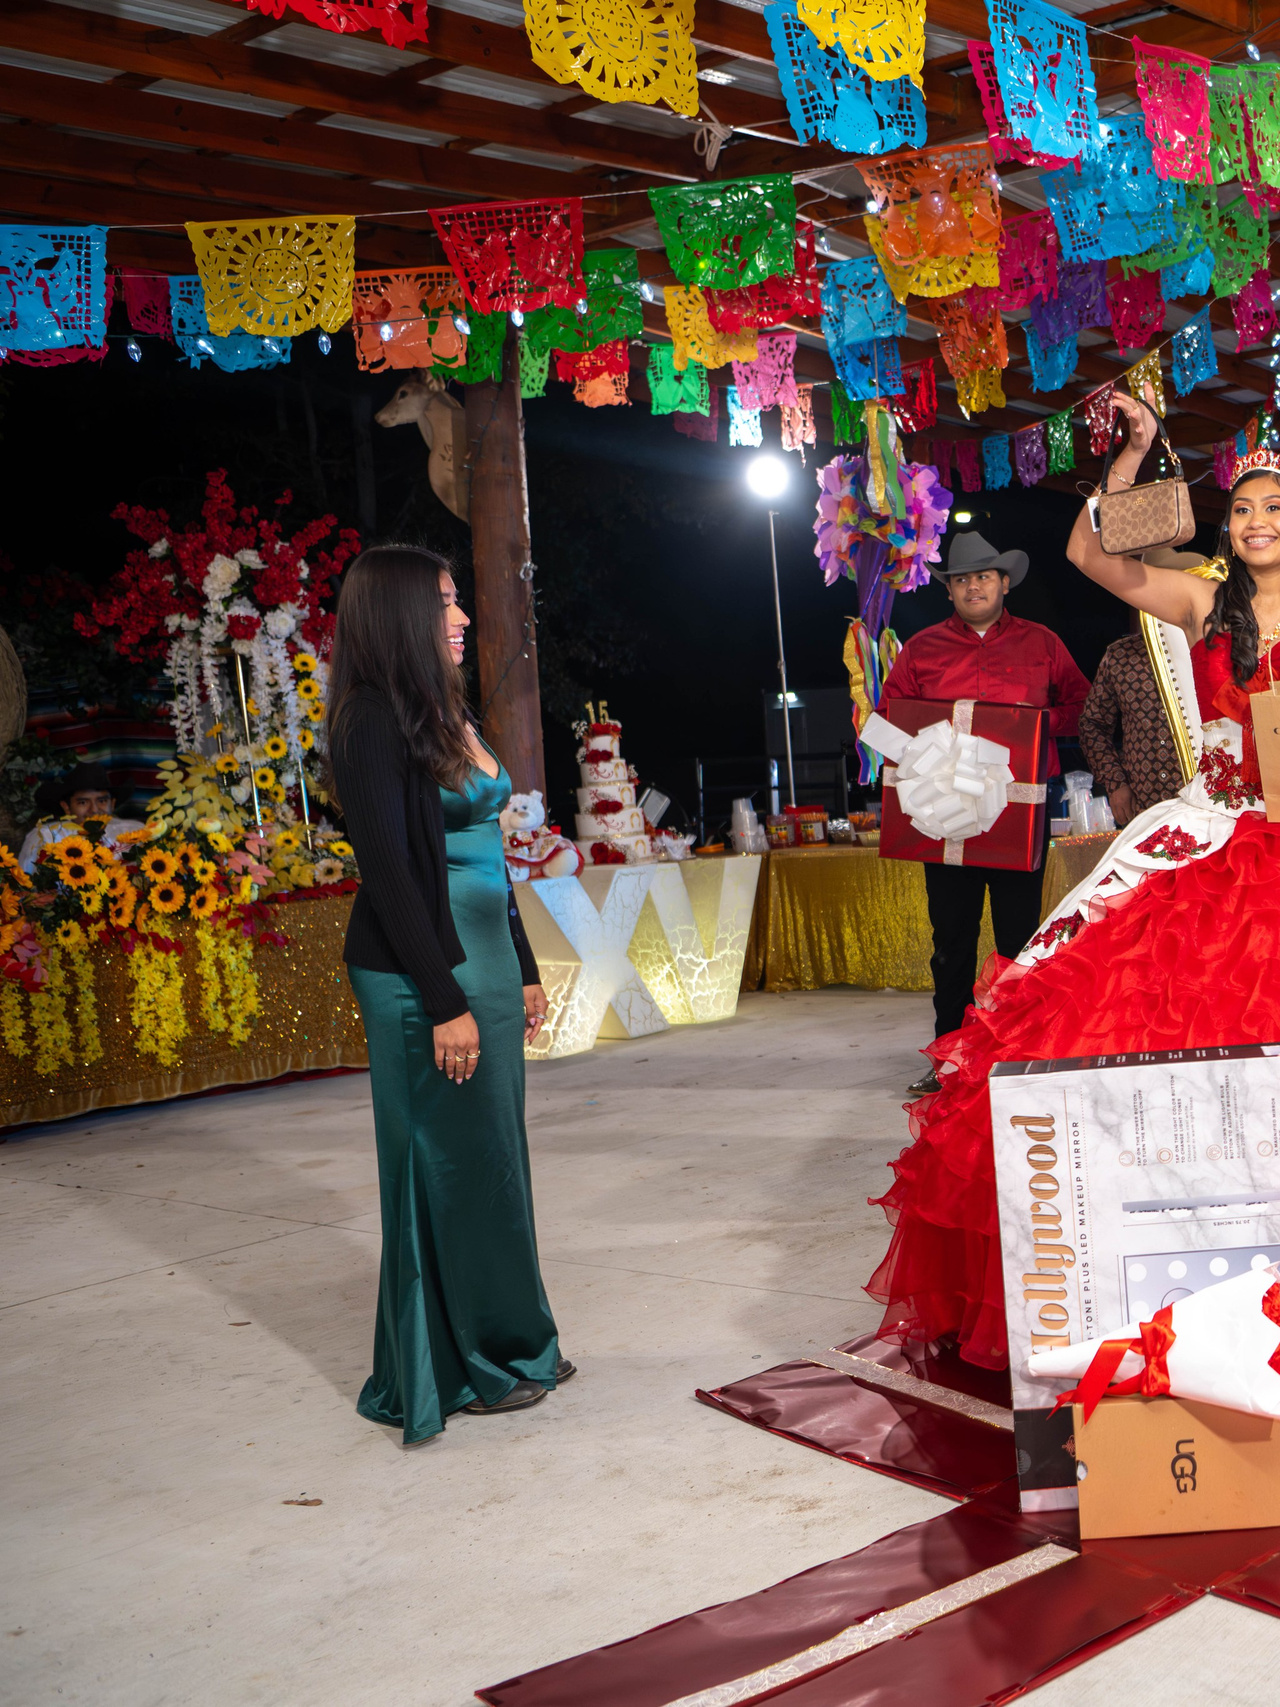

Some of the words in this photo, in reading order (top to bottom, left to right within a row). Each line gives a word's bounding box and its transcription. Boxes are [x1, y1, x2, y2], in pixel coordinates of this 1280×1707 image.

[584, 700, 609, 724] 15
[1072, 1121, 1082, 1168] MIRROR
[1076, 1176, 1086, 1226] MAKEUP
[1080, 1234, 1088, 1255] LED
[1082, 1262, 1090, 1291] PLUS
[1171, 1439, 1197, 1493] UGG
